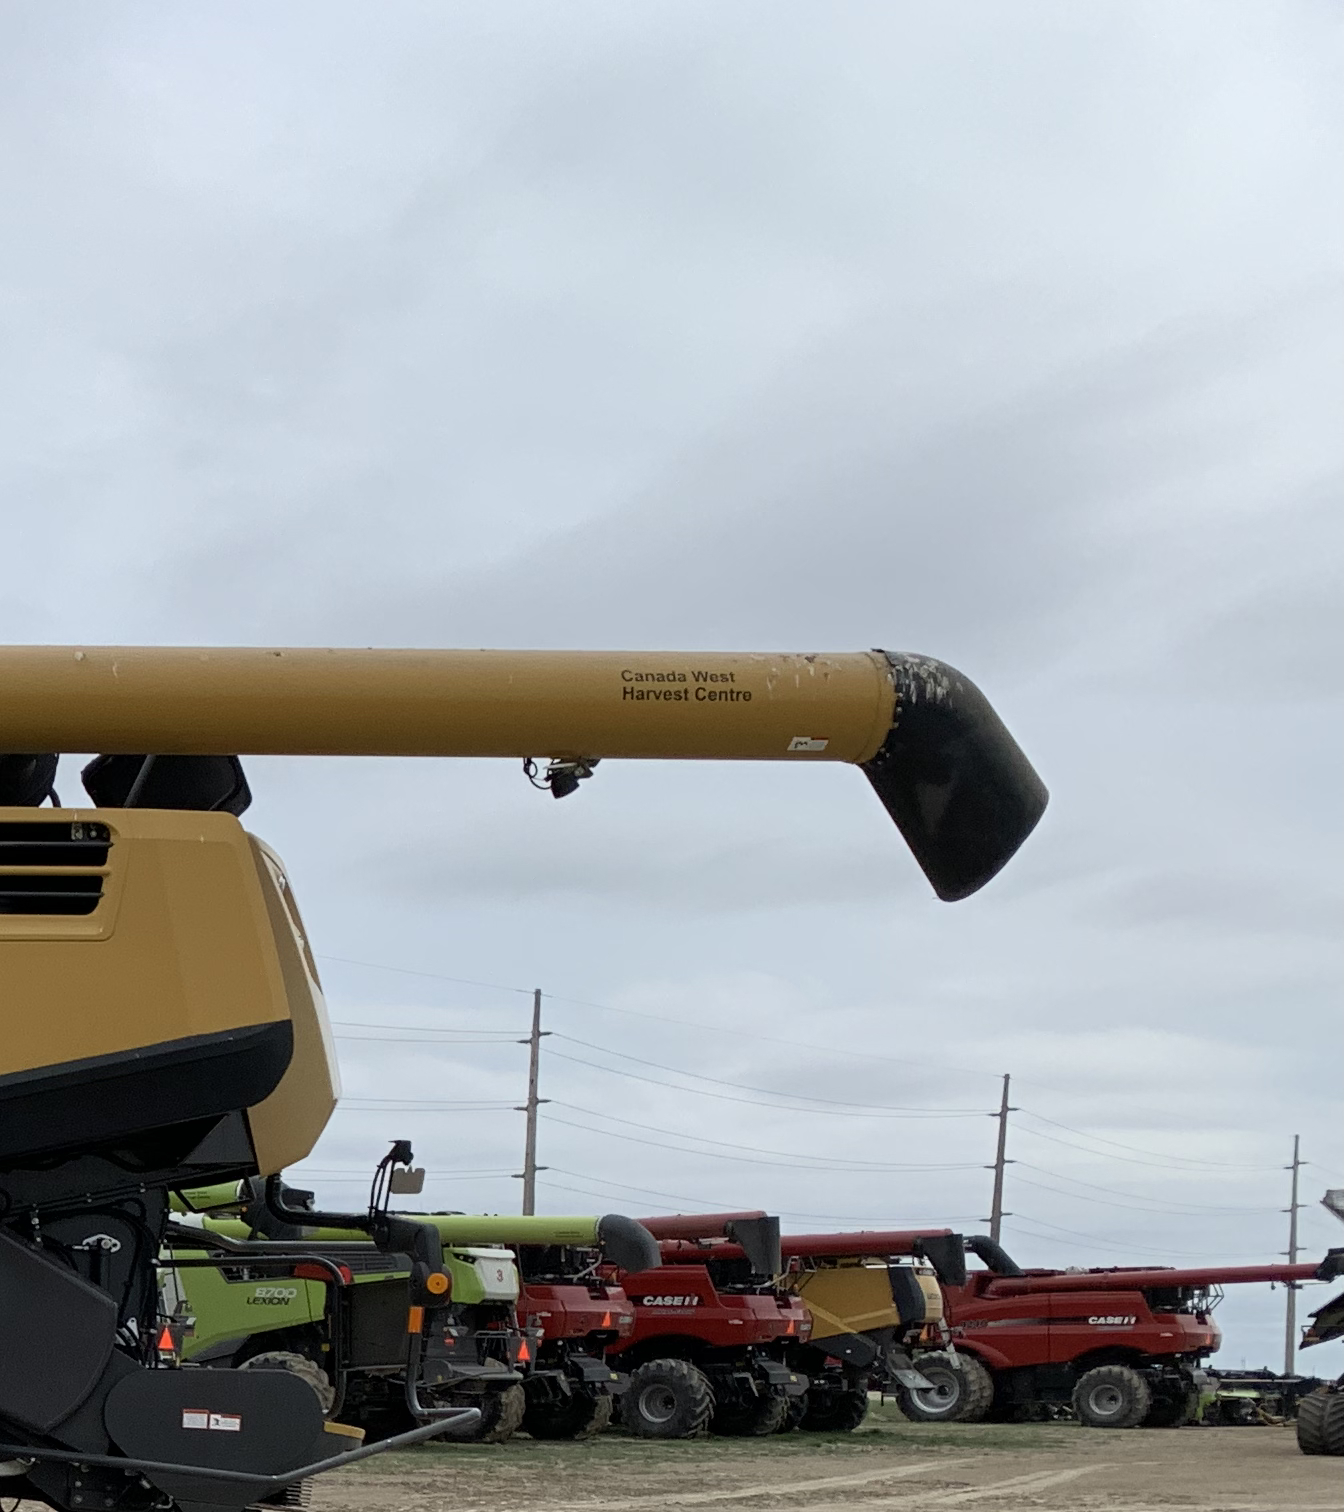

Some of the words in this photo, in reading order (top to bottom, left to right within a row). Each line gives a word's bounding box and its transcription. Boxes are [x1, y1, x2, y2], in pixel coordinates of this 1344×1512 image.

[620, 669, 687, 683] Canada
[691, 670, 736, 683] West
[622, 686, 690, 702] Harvest
[694, 687, 753, 702] Centre
[497, 1269, 503, 1282] 3
[246, 1297, 290, 1306] LEXION
[642, 1295, 684, 1306] CASE
[1088, 1316, 1123, 1325] CASE
